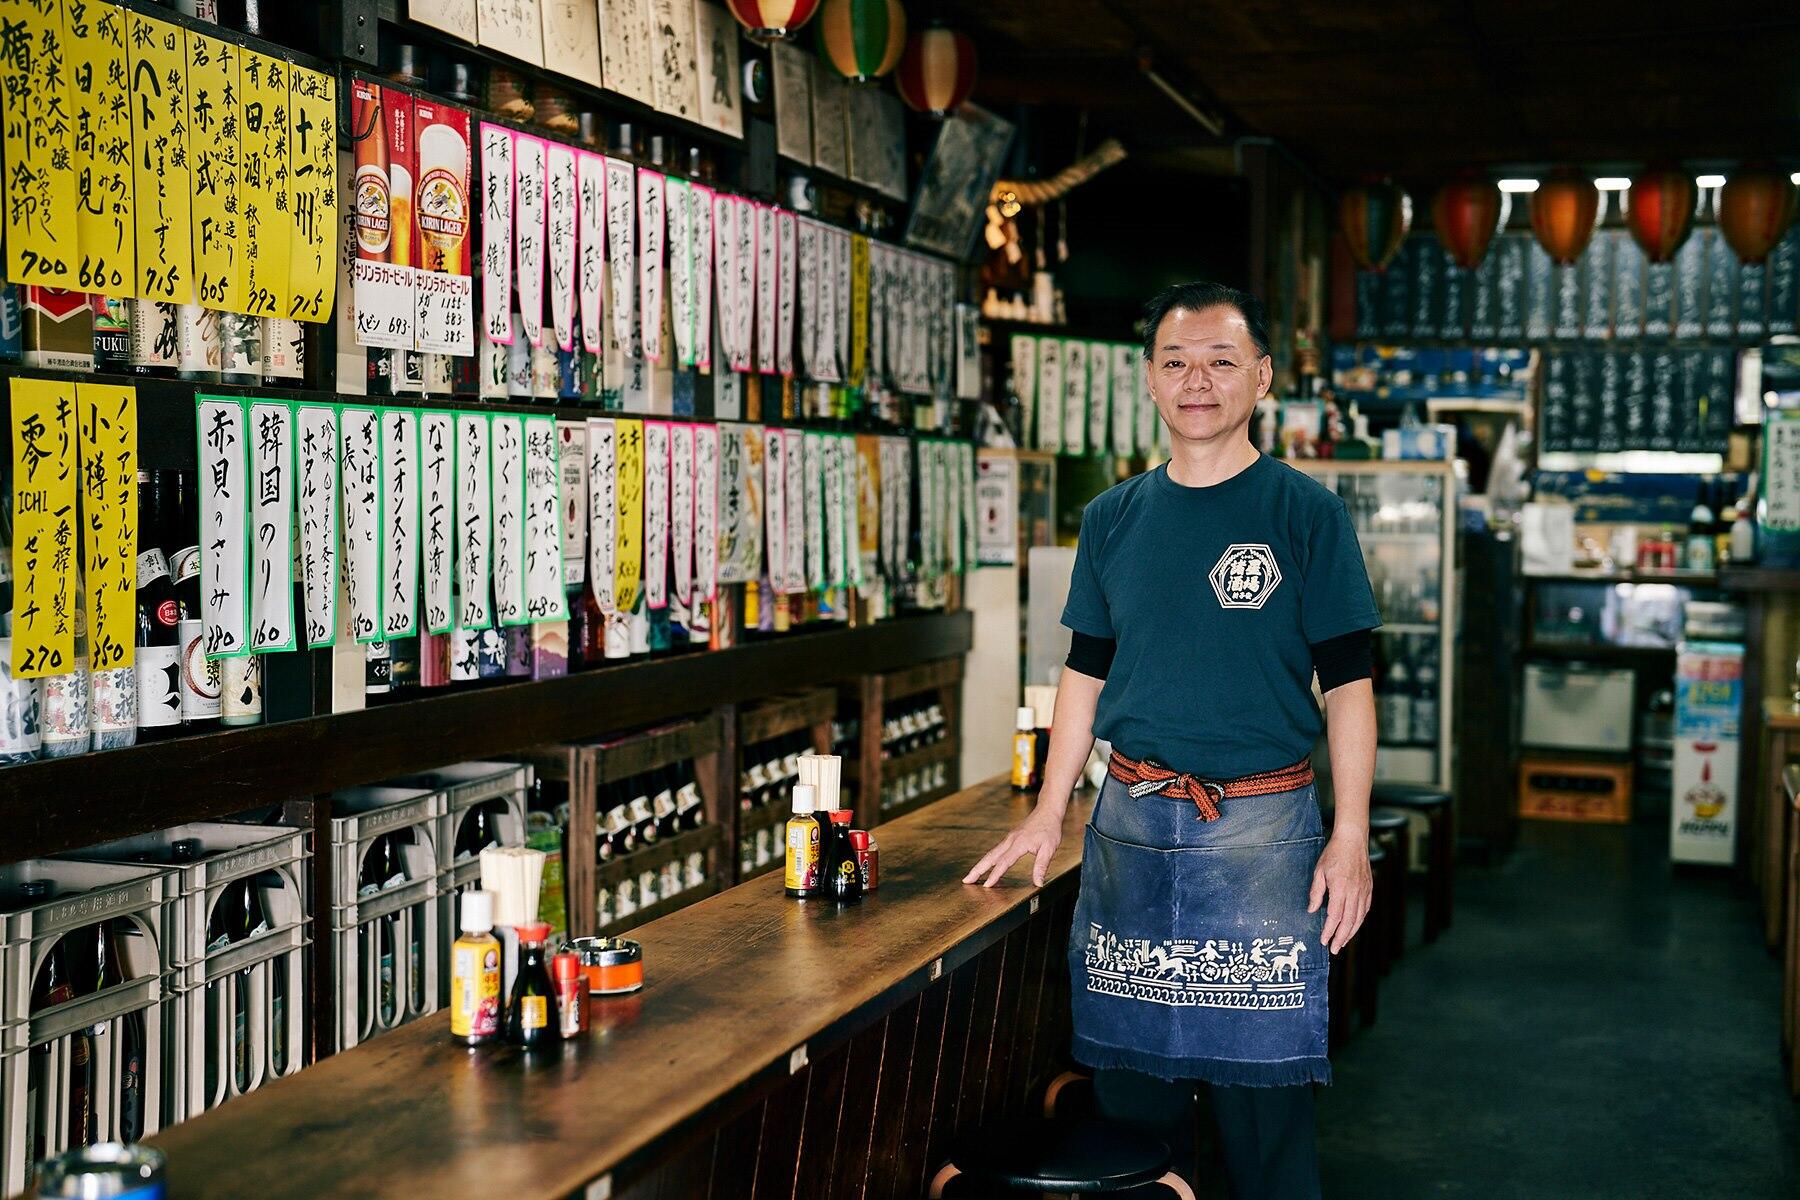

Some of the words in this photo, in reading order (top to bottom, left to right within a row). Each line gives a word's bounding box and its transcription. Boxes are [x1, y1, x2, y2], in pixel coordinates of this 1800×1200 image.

[68, 2, 123, 49] 宮城
[131, 17, 176, 51] 秋田
[192, 36, 234, 73] 岩手
[244, 55, 286, 91] 青森
[291, 69, 333, 102] 北海道
[39, 29, 74, 172] 純米大吟醸
[74, 61, 104, 216] 日高見
[165, 69, 189, 172] 純米吟醸
[192, 89, 217, 196] 赤武
[244, 101, 264, 190] 田酒
[272, 104, 289, 213] 純米吟醸
[294, 107, 314, 245] 十一州
[320, 116, 337, 210] 純米吟醸
[37, 167, 57, 243] ひやおろし
[371, 217, 388, 231] LAGER
[421, 215, 440, 231] KIRIN
[440, 219, 462, 235] LAGER
[20, 249, 68, 278] 700
[78, 255, 123, 287] 660
[355, 263, 413, 288] キリンラガービール
[434, 250, 449, 274] 生
[145, 265, 181, 296] 715
[200, 272, 229, 303] 605
[416, 275, 470, 296] キリンラガービール
[247, 288, 277, 314] 792
[289, 289, 324, 318] 715
[418, 293, 434, 307] メガ
[420, 307, 428, 324] 中
[358, 311, 380, 333] 大ビン
[56, 397, 73, 482] キリン
[321, 418, 336, 464] 珍味
[116, 397, 134, 593] ノンアルコールビール
[361, 414, 378, 541] ぎばさと
[18, 491, 48, 515] ICHI
[207, 408, 235, 613] 赤貝のさしみ
[259, 411, 285, 600] 韓国のり
[393, 413, 406, 603] オニオンスライス
[428, 421, 445, 596] なすの一本漬け
[464, 422, 481, 593] きゅうりの一本漬け
[21, 529, 45, 631] ゼロイチ
[52, 504, 73, 636] 一番搾り製法
[387, 613, 409, 631] 220
[464, 602, 483, 625] 270
[528, 596, 559, 617] 480
[93, 633, 124, 670] 350
[206, 625, 235, 653] 380
[253, 619, 280, 650] 160
[19, 644, 63, 673] 270
